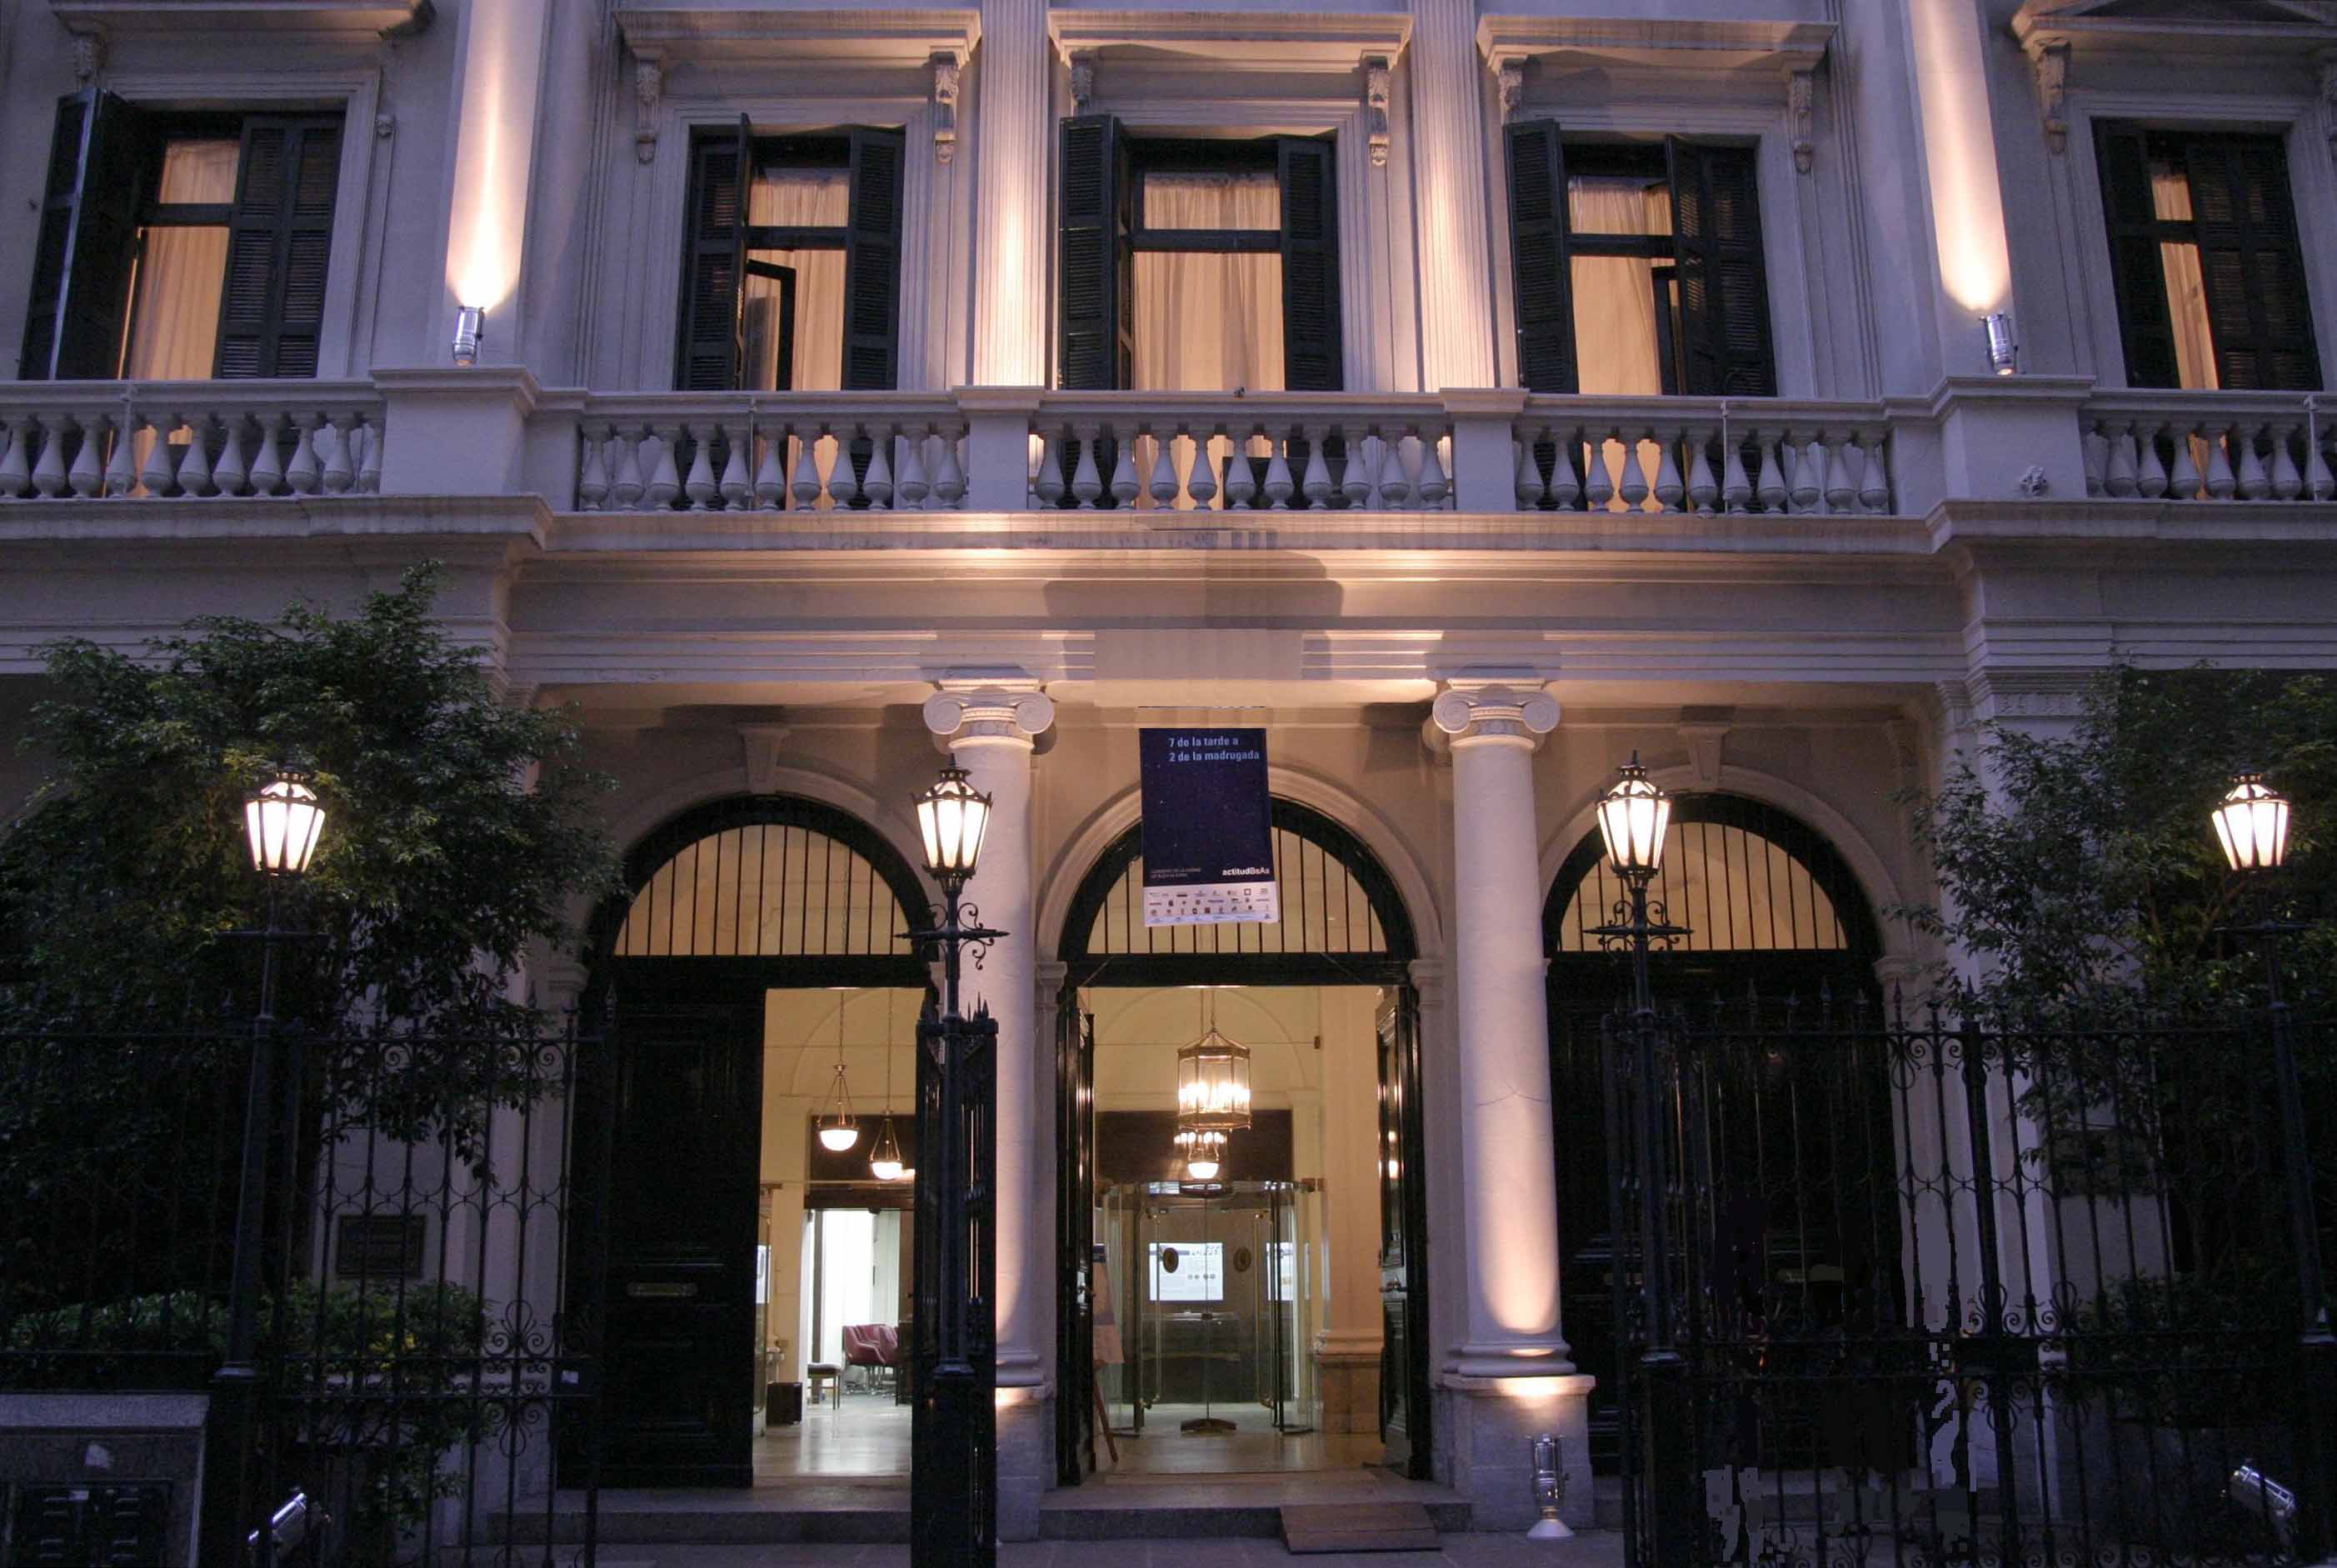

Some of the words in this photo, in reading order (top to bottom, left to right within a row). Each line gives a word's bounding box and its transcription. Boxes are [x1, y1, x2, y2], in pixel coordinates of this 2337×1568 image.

[1168, 737, 1175, 747] 7
[1177, 737, 1190, 747] de
[1192, 737, 1201, 747] la
[1204, 736, 1231, 746] tarde
[1169, 752, 1176, 762] 2
[1178, 752, 1190, 762] de
[1193, 751, 1202, 761] la
[1205, 750, 1260, 762] madrugada
